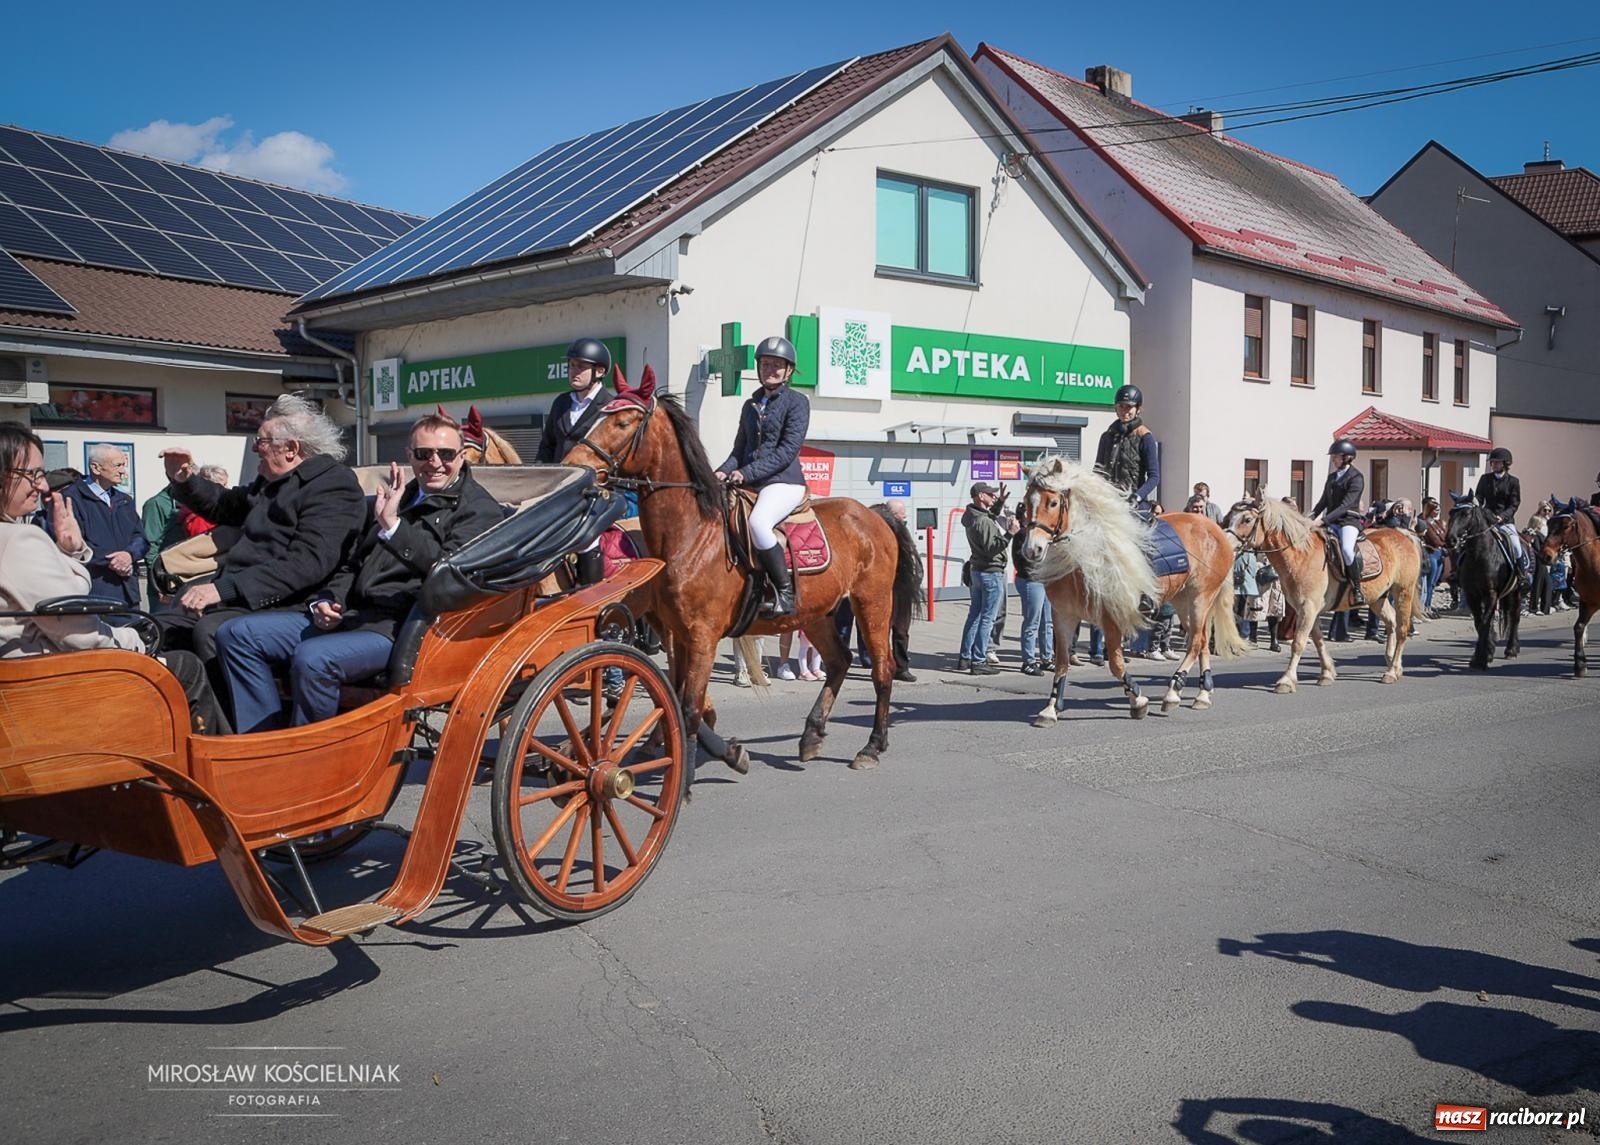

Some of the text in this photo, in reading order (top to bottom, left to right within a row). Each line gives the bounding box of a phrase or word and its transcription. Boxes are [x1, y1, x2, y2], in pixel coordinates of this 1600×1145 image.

[407, 365, 476, 394] APTEKA
[906, 346, 1113, 389] APTEKA ZIELONA
